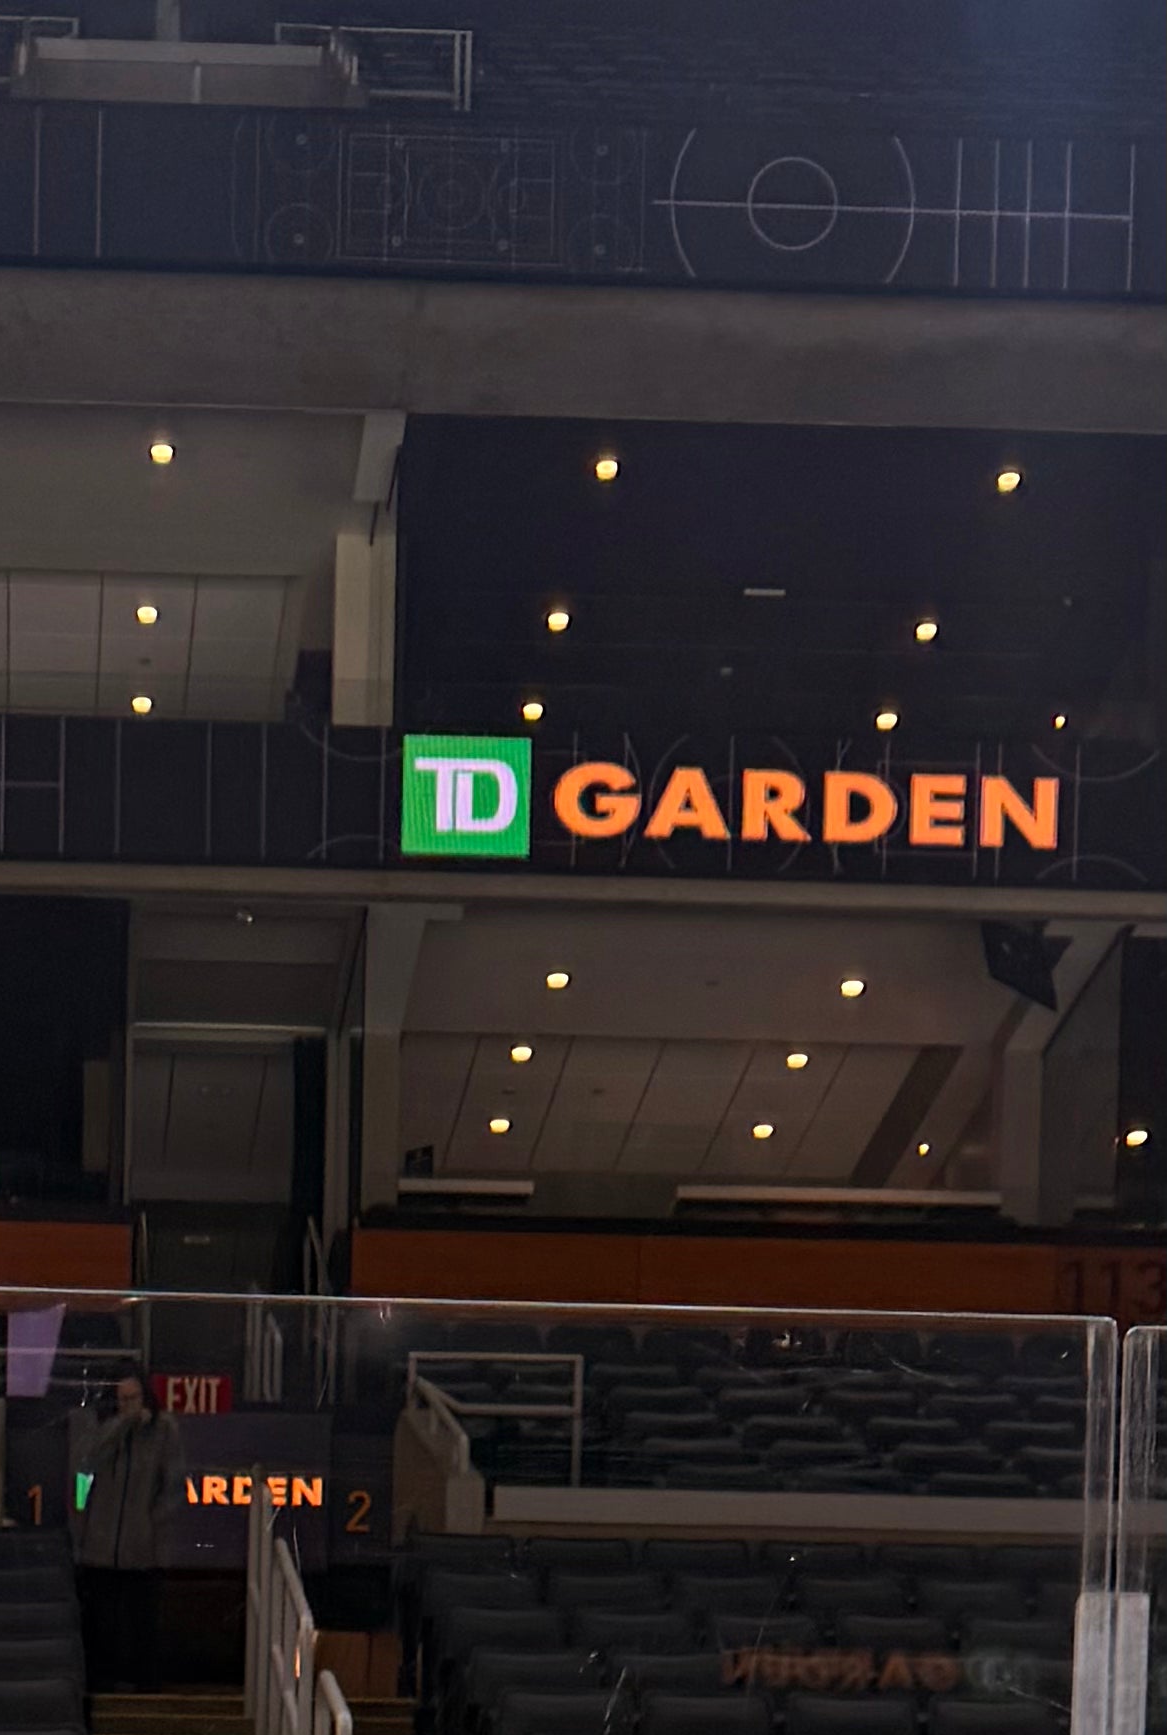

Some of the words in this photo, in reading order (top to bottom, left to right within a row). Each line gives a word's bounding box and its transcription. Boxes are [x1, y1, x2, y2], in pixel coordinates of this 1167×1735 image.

[415, 755, 517, 834] TD
[553, 761, 1061, 851] GARDEN
[167, 1376, 222, 1415] EXIT
[27, 1485, 43, 1526] 1
[345, 1489, 373, 1534] 2
